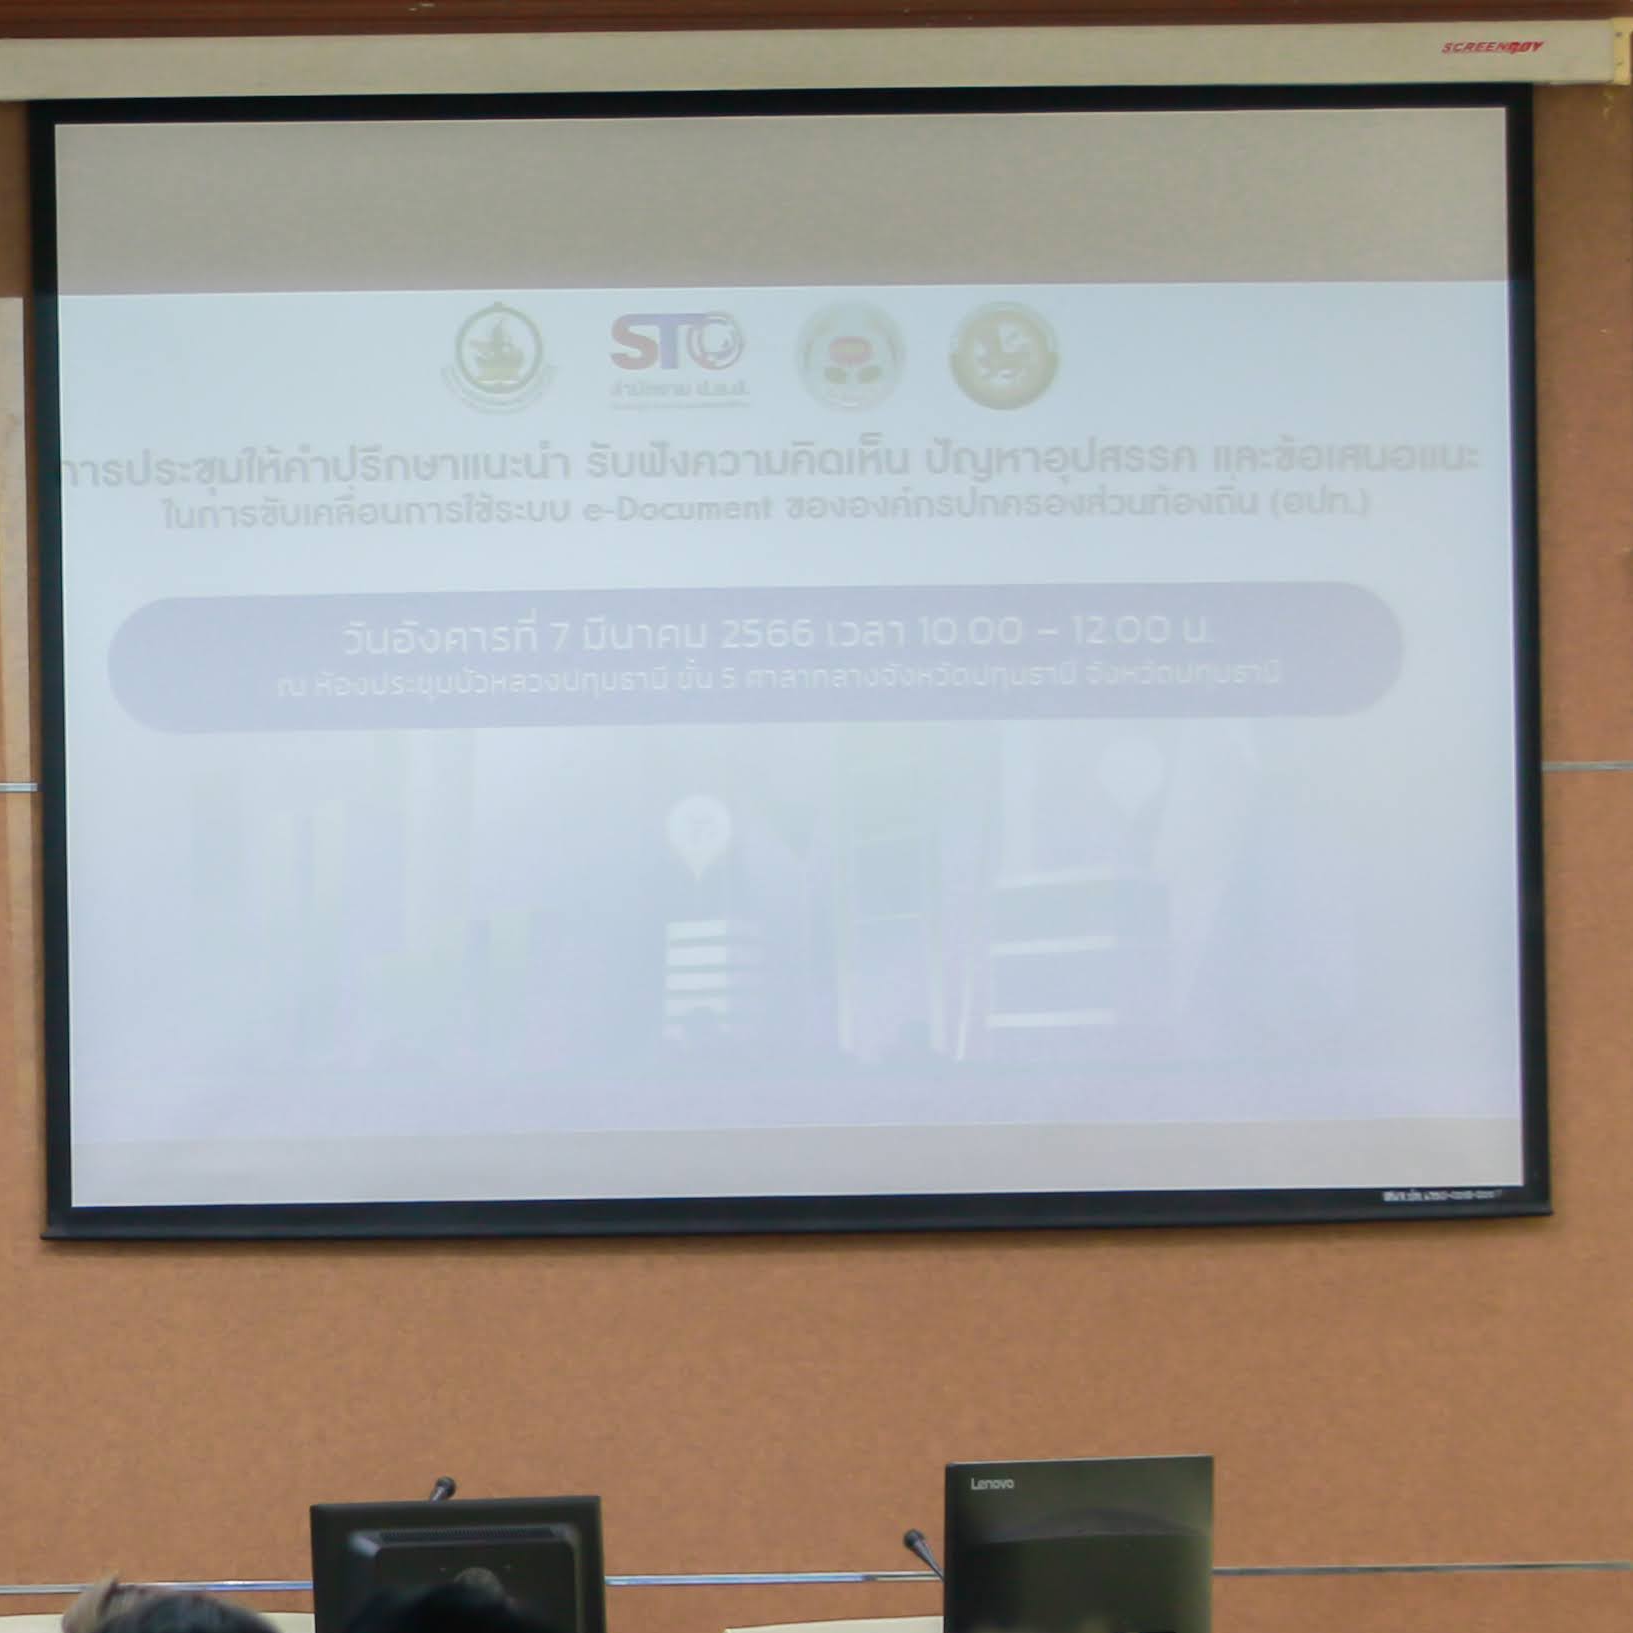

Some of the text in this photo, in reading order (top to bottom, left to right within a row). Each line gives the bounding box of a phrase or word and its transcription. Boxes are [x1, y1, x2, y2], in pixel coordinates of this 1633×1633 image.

[61, 431, 1481, 497] การประชุมให้คำปรึกษาแนะนำ รับฟังความคิดเห็น ปัญหาอุปสรรค และข้อเสนอแนะ
[159, 482, 572, 529] ในการขับเคลื่อนการใช้ระบบ
[583, 495, 774, 523] e-Document
[785, 472, 1260, 521] ขององค์กรปกครองส่วนท้องถิ่น
[341, 609, 539, 656] วันอังคารที่
[549, 621, 570, 654] 7
[581, 612, 708, 652] มีนาคม
[720, 617, 815, 649] 2566
[827, 619, 906, 648] เวลา
[970, 1477, 1015, 1491] Lenovo
